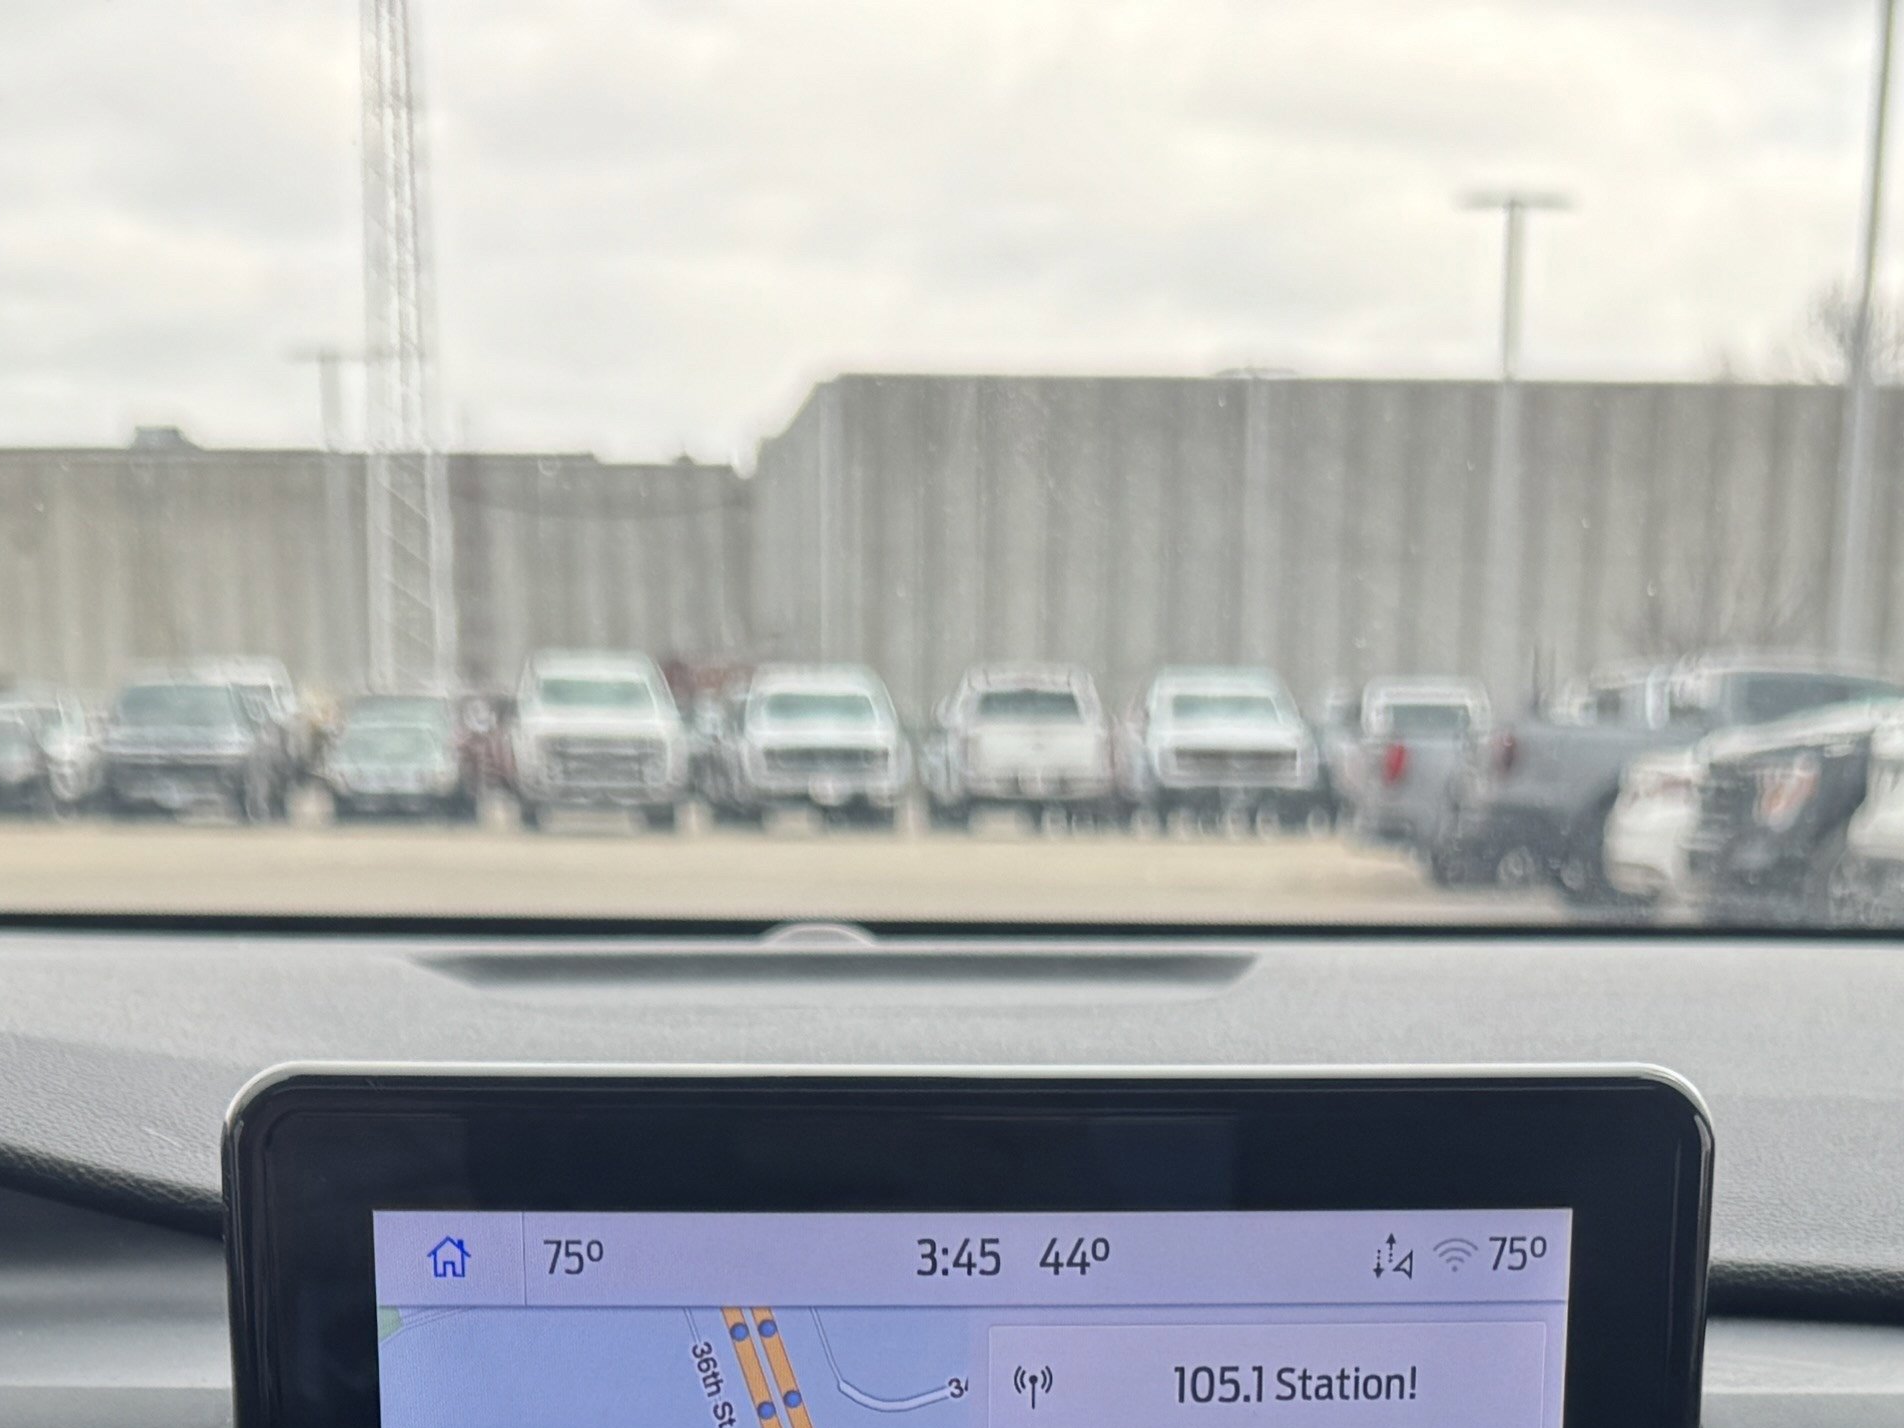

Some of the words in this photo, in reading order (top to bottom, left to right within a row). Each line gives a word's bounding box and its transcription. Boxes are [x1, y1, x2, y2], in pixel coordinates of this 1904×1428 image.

[916, 1237, 1001, 1277] 3:45
[690, 1340, 724, 1399] 36th
[1174, 1365, 1263, 1404] 105.1
[1275, 1365, 1417, 1401] Station!
